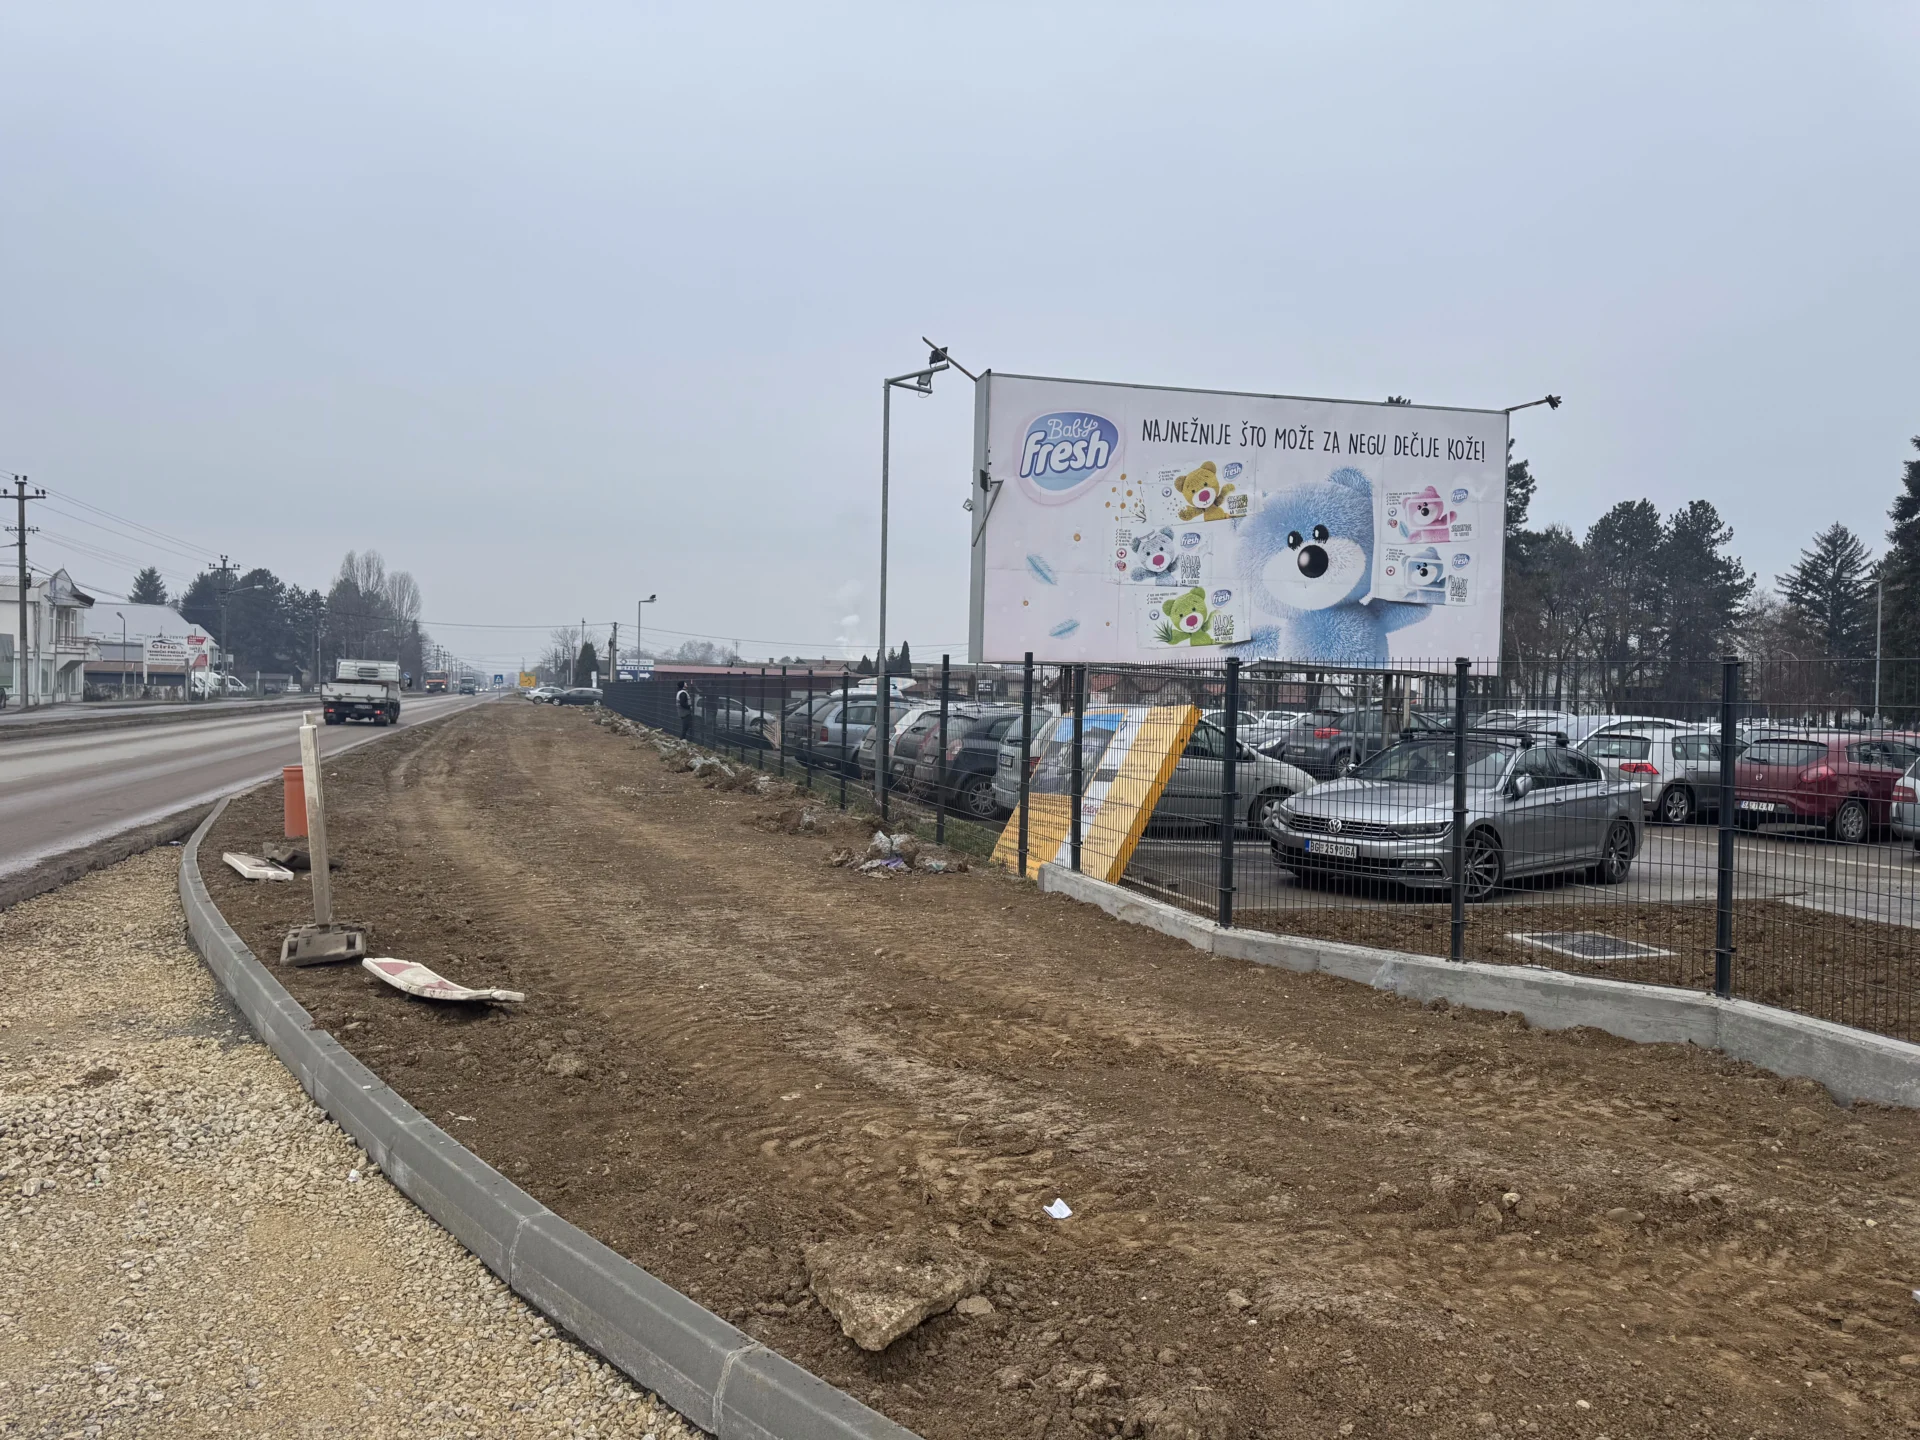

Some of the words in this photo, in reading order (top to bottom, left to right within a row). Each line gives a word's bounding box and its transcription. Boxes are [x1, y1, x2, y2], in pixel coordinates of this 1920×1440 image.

[1047, 416, 1099, 439] Baby
[1142, 417, 1231, 445] NAJNEŽNIJE
[1239, 420, 1266, 448] ŠTO
[1274, 424, 1315, 450] MOŽE
[1323, 431, 1340, 454] ZA
[1348, 433, 1386, 455] NEGU
[1394, 432, 1440, 458] DEČIJE
[1447, 436, 1485, 463] KOŽE!
[1020, 429, 1111, 478] fresh
[1310, 841, 1320, 852] BG
